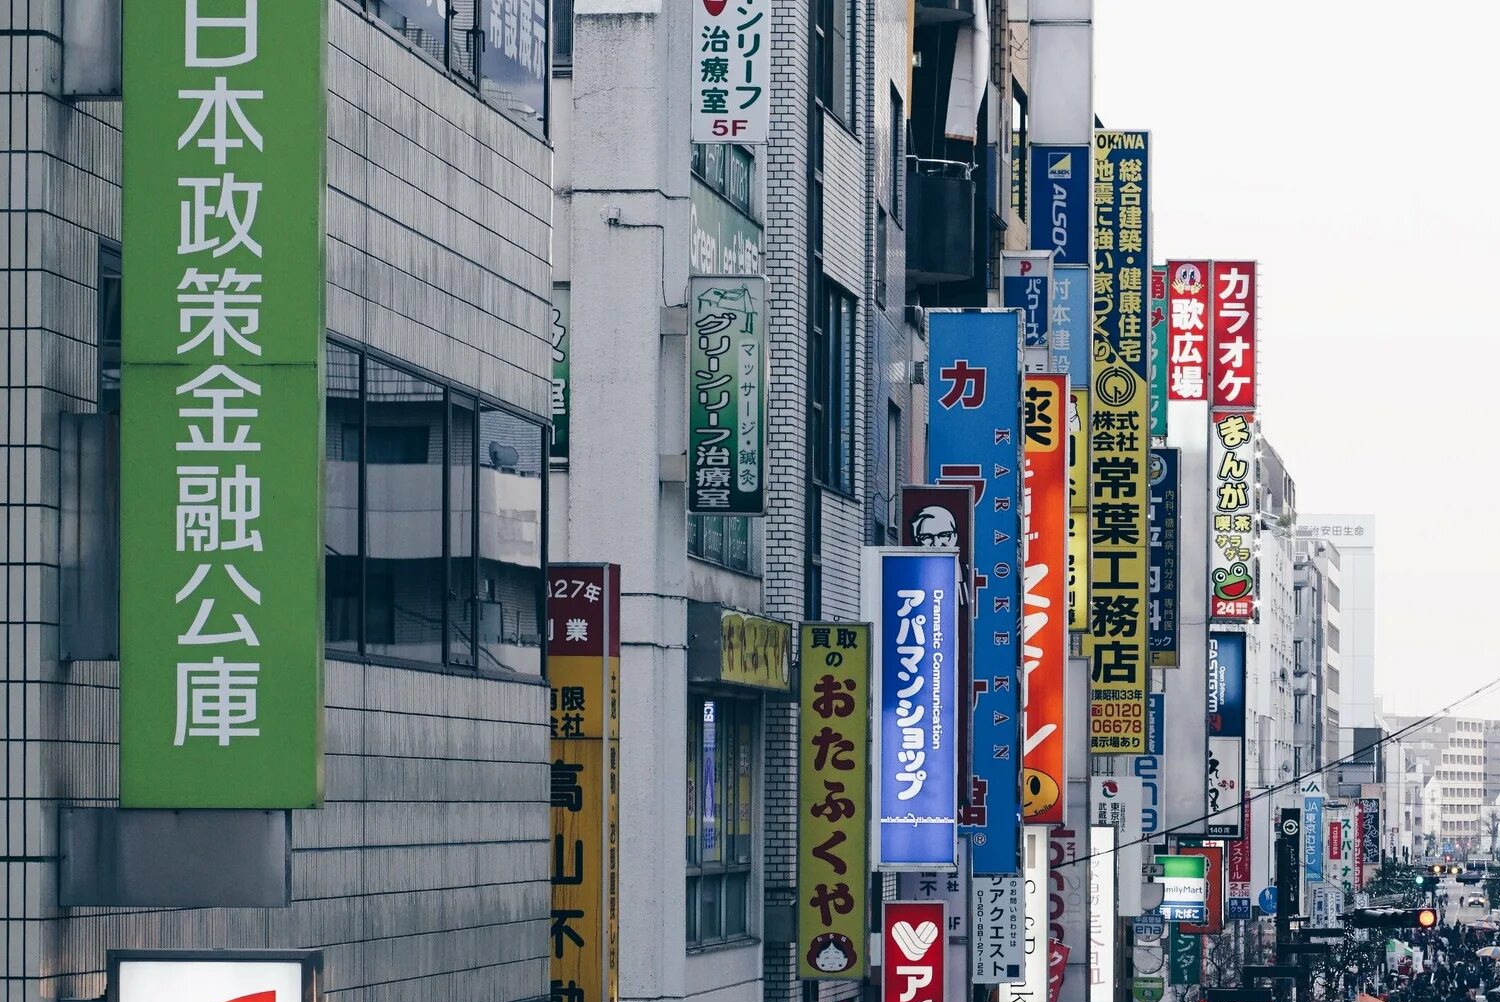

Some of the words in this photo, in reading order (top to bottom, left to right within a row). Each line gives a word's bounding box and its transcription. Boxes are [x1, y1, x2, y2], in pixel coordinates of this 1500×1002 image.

[700, 25, 729, 114] 治療室
[736, 0, 763, 110] ンリーフ
[712, 119, 748, 137] 5F
[1052, 182, 1068, 258] ALSOK
[1118, 158, 1143, 363] 総合建築・健康住宅
[1025, 278, 1042, 339] パワーズ
[1171, 298, 1205, 399] 歌広場
[1218, 267, 1251, 402] カラオケ
[176, 0, 263, 746] 日本政策金融公庫
[695, 312, 737, 508] グリーンリーフ治療室
[739, 343, 757, 487] マッサージ・鍼灸
[1093, 410, 1139, 430] 株式
[1093, 432, 1139, 452] 会社
[1217, 415, 1250, 512] まんが
[548, 579, 602, 603] 27年
[1092, 456, 1140, 684] 常葉工務店
[1216, 602, 1235, 616] 24
[811, 628, 858, 650] 買取
[825, 651, 843, 668] の
[932, 589, 943, 650] Dramatic
[895, 589, 927, 801] アパマンショップ
[932, 652, 943, 750] Communication
[1092, 719, 1142, 734] 06678
[1105, 703, 1142, 718] 0120
[810, 673, 857, 928] おたふくや
[1175, 907, 1200, 920] たばこ
